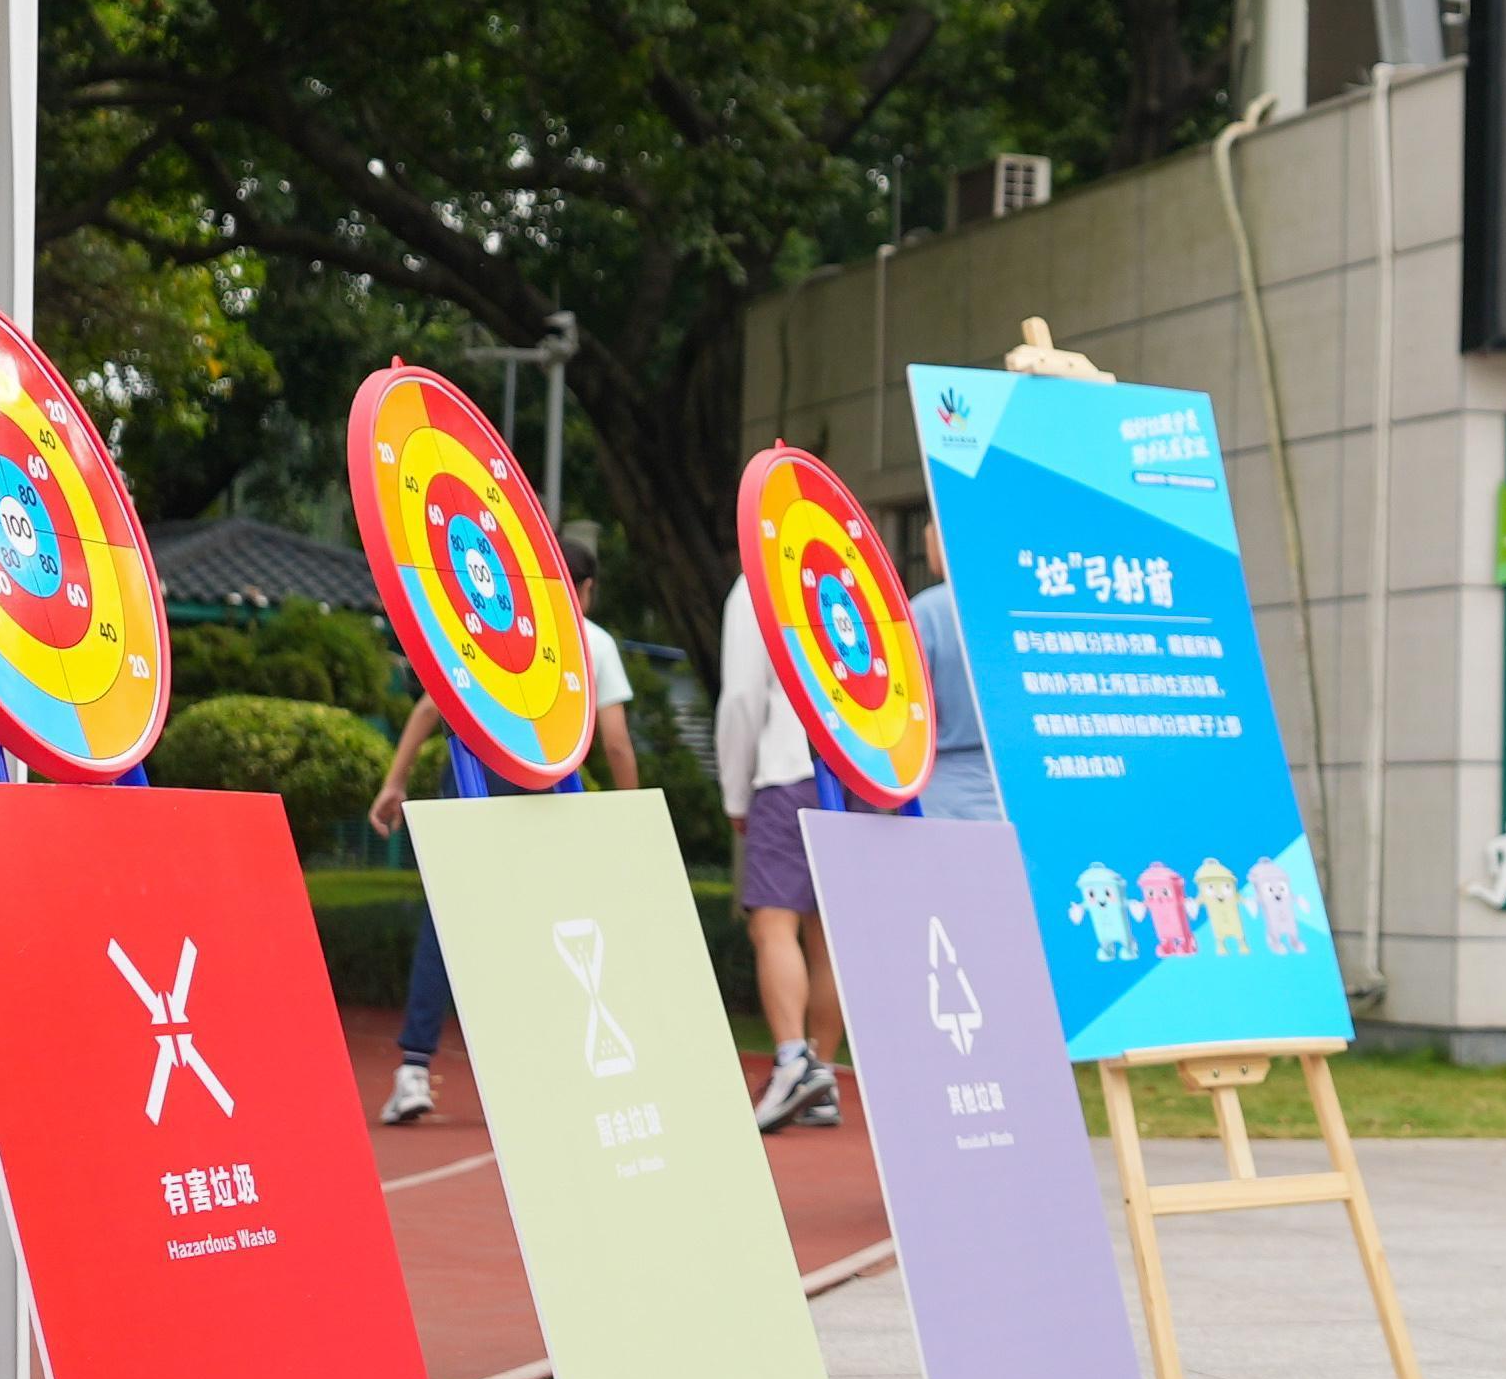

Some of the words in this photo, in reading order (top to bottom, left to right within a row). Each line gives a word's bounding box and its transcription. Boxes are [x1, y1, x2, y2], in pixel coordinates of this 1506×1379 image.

[45, 399, 67, 424] 20
[39, 429, 56, 450] 40
[377, 442, 394, 464] 20
[28, 454, 48, 480] 60
[491, 458, 507, 480] 20
[18, 485, 37, 506] 80
[406, 476, 419, 494] 40
[486, 486, 500, 504] 40
[428, 504, 444, 526] 60
[480, 509, 497, 532] 60
[2, 513, 32, 540] 100
[451, 535, 465, 552] 80
[477, 536, 490, 554] 80
[1, 547, 20, 568] 80
[39, 554, 58, 575] 80
[468, 563, 490, 583] 100
[1017, 550, 1174, 609] “垃”弓射箭
[67, 582, 88, 608] 60
[472, 591, 486, 609] 80
[497, 594, 510, 611] 80
[100, 623, 117, 643] 40
[466, 612, 482, 635] 60
[517, 616, 534, 637] 60
[462, 643, 476, 660] 40
[542, 646, 555, 663] 40
[129, 654, 150, 680] 20
[453, 667, 470, 689] 20
[564, 671, 581, 692] 20
[160, 1163, 259, 1216] 有害垃圾
[166, 1233, 237, 1260] Hazardous
[236, 1226, 277, 1248] Waste
